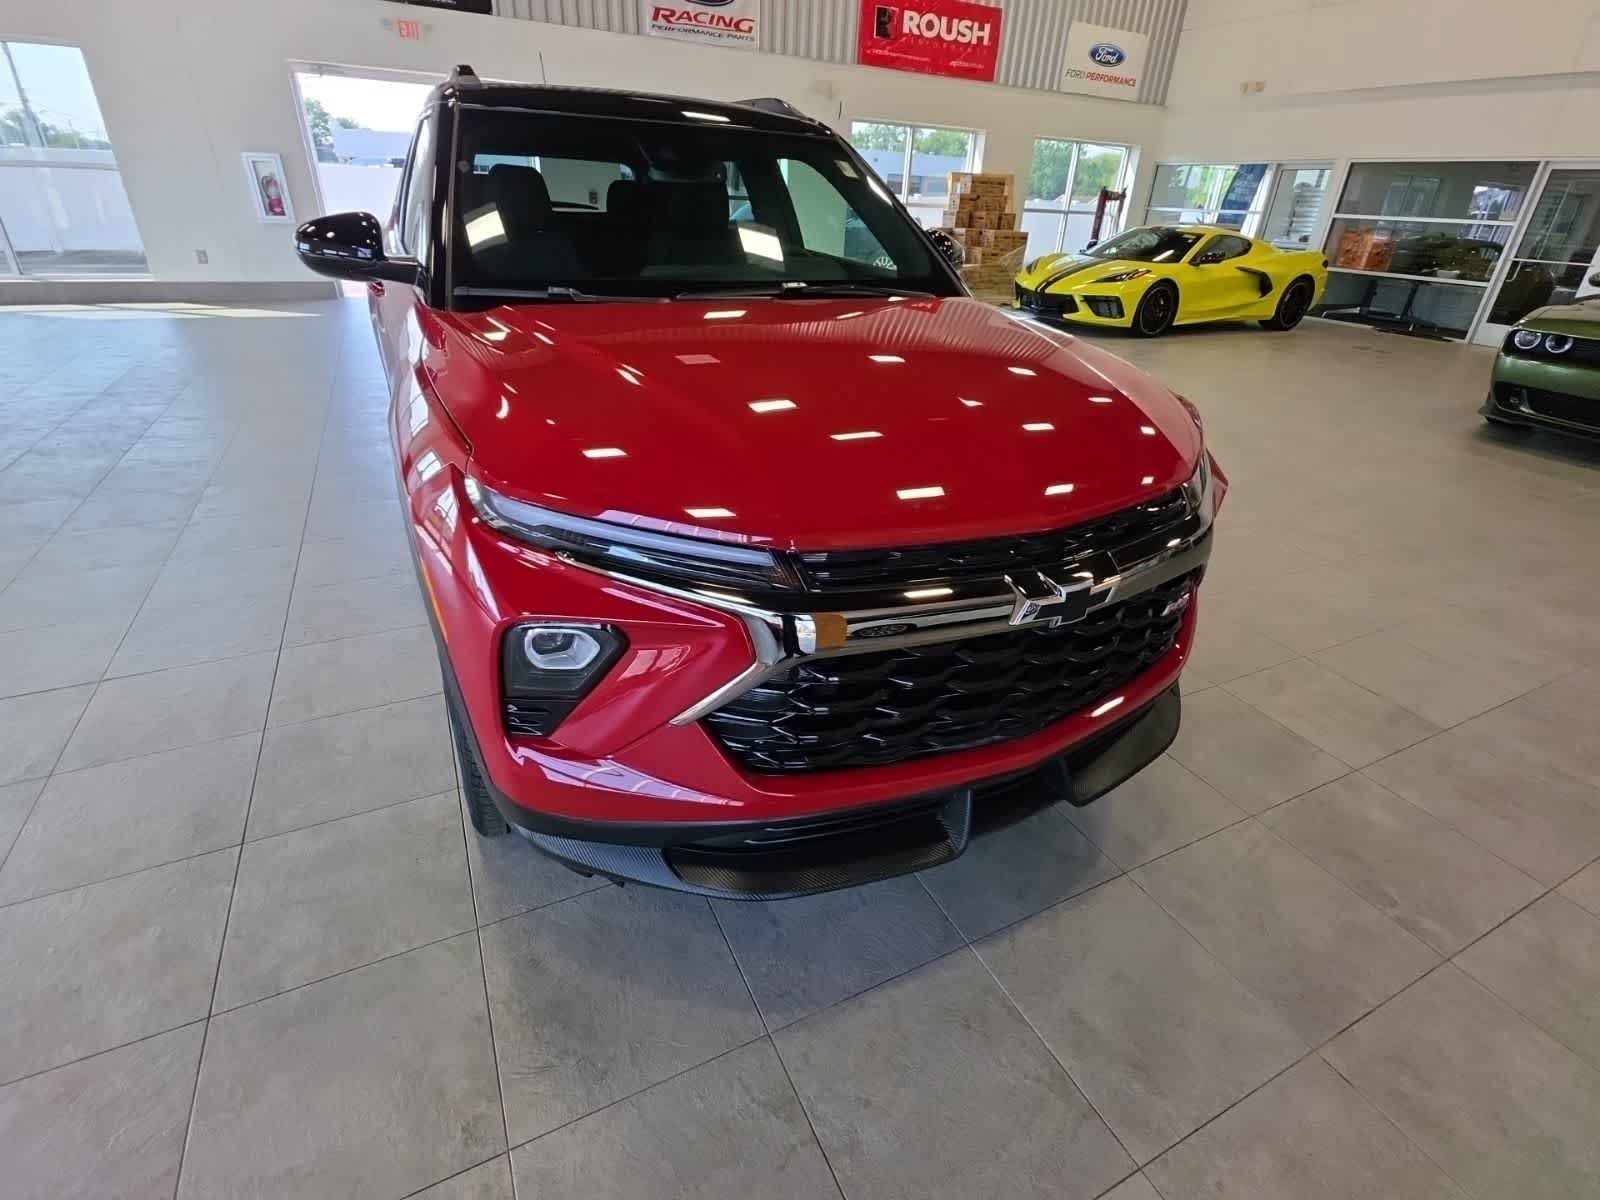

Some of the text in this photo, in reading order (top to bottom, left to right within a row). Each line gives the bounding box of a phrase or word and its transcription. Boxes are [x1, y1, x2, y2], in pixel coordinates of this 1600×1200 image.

[652, 6, 755, 34] RACING
[902, 10, 991, 46] ROUSH
[1095, 46, 1119, 63] Ford
[1086, 71, 1137, 87] PERFORMANCE
